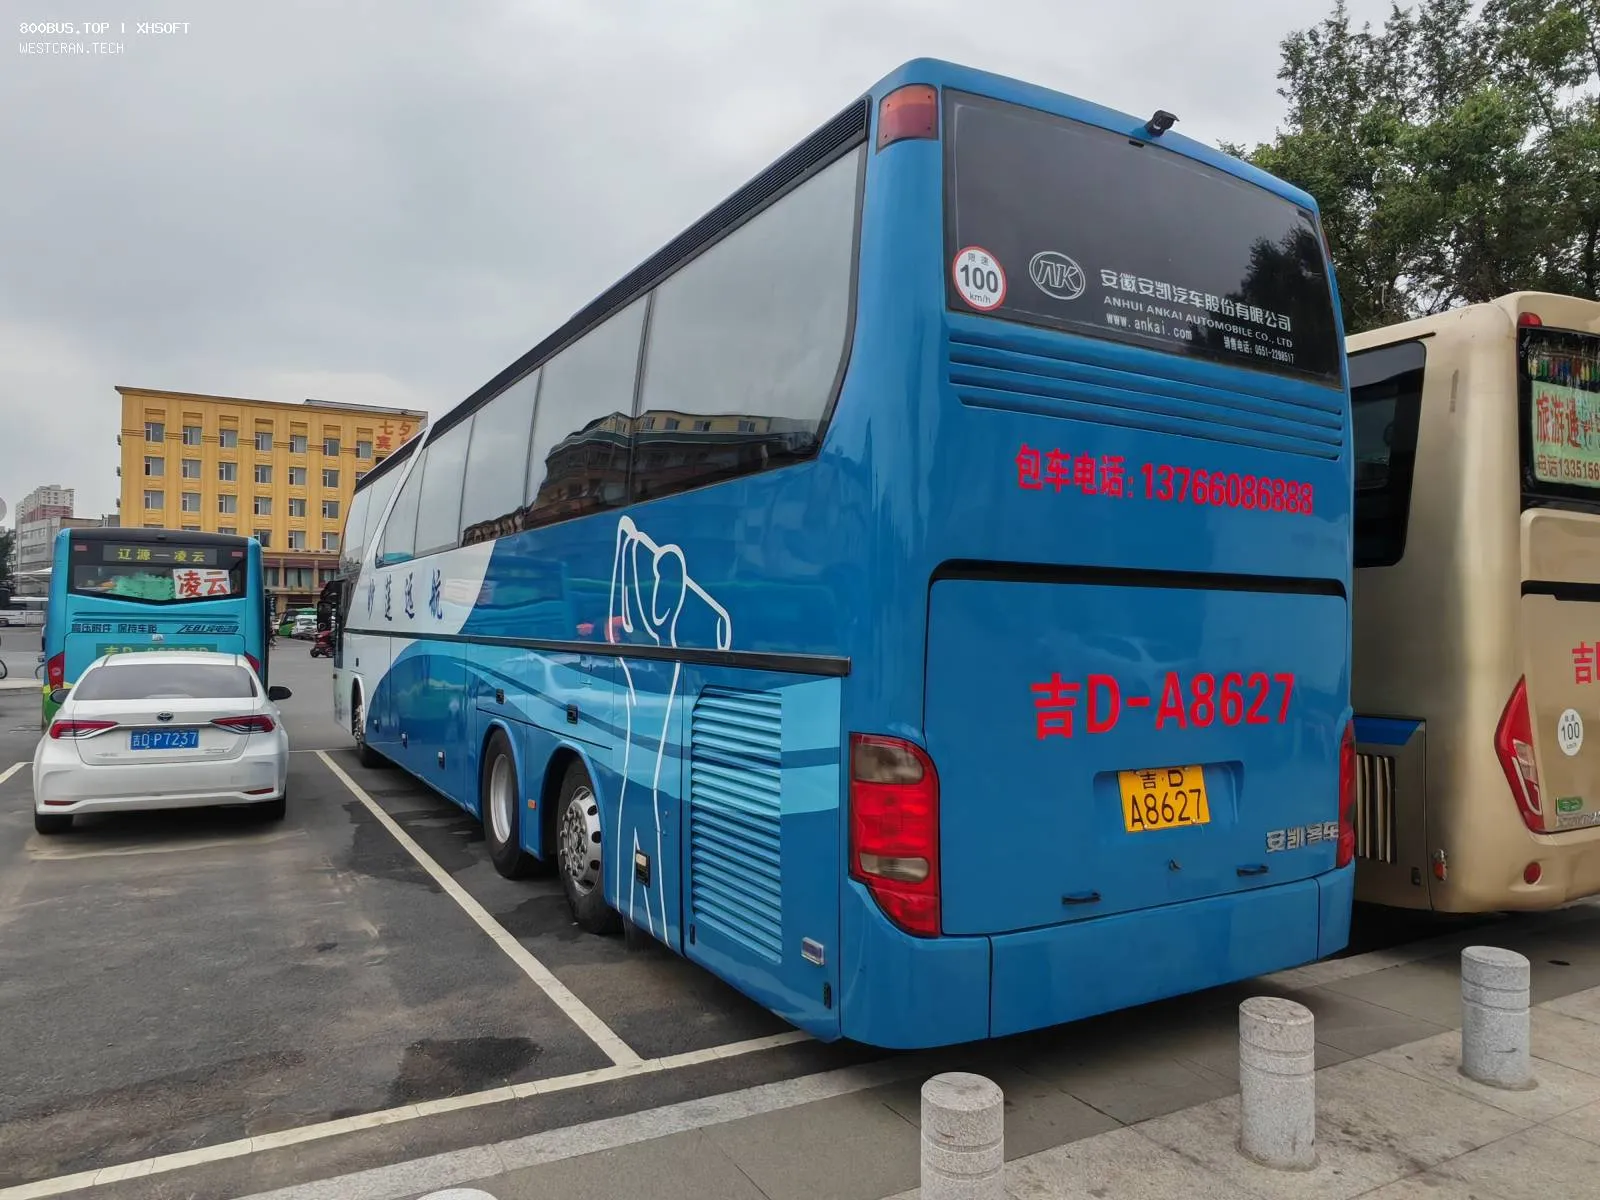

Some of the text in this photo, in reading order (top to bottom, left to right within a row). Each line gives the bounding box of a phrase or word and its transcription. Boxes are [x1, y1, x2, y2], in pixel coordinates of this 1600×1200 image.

[959, 264, 999, 294] 100
[969, 291, 991, 304] km/h
[1100, 269, 1292, 332] 安徽安凯汽车股份有限公司
[1103, 295, 1143, 312] ANHUI
[1146, 304, 1183, 321] ANKAI
[1185, 313, 1253, 338] AUTOMOBILE
[1276, 336, 1293, 348] LTD
[1106, 312, 1193, 341] www.ankai.com
[176, 570, 231, 599] 凌云
[1030, 671, 1296, 740] 吉D-A8627
[1560, 721, 1581, 741] 100
[1130, 788, 1202, 829] A8627
[1264, 821, 1340, 853] 安凯客车
